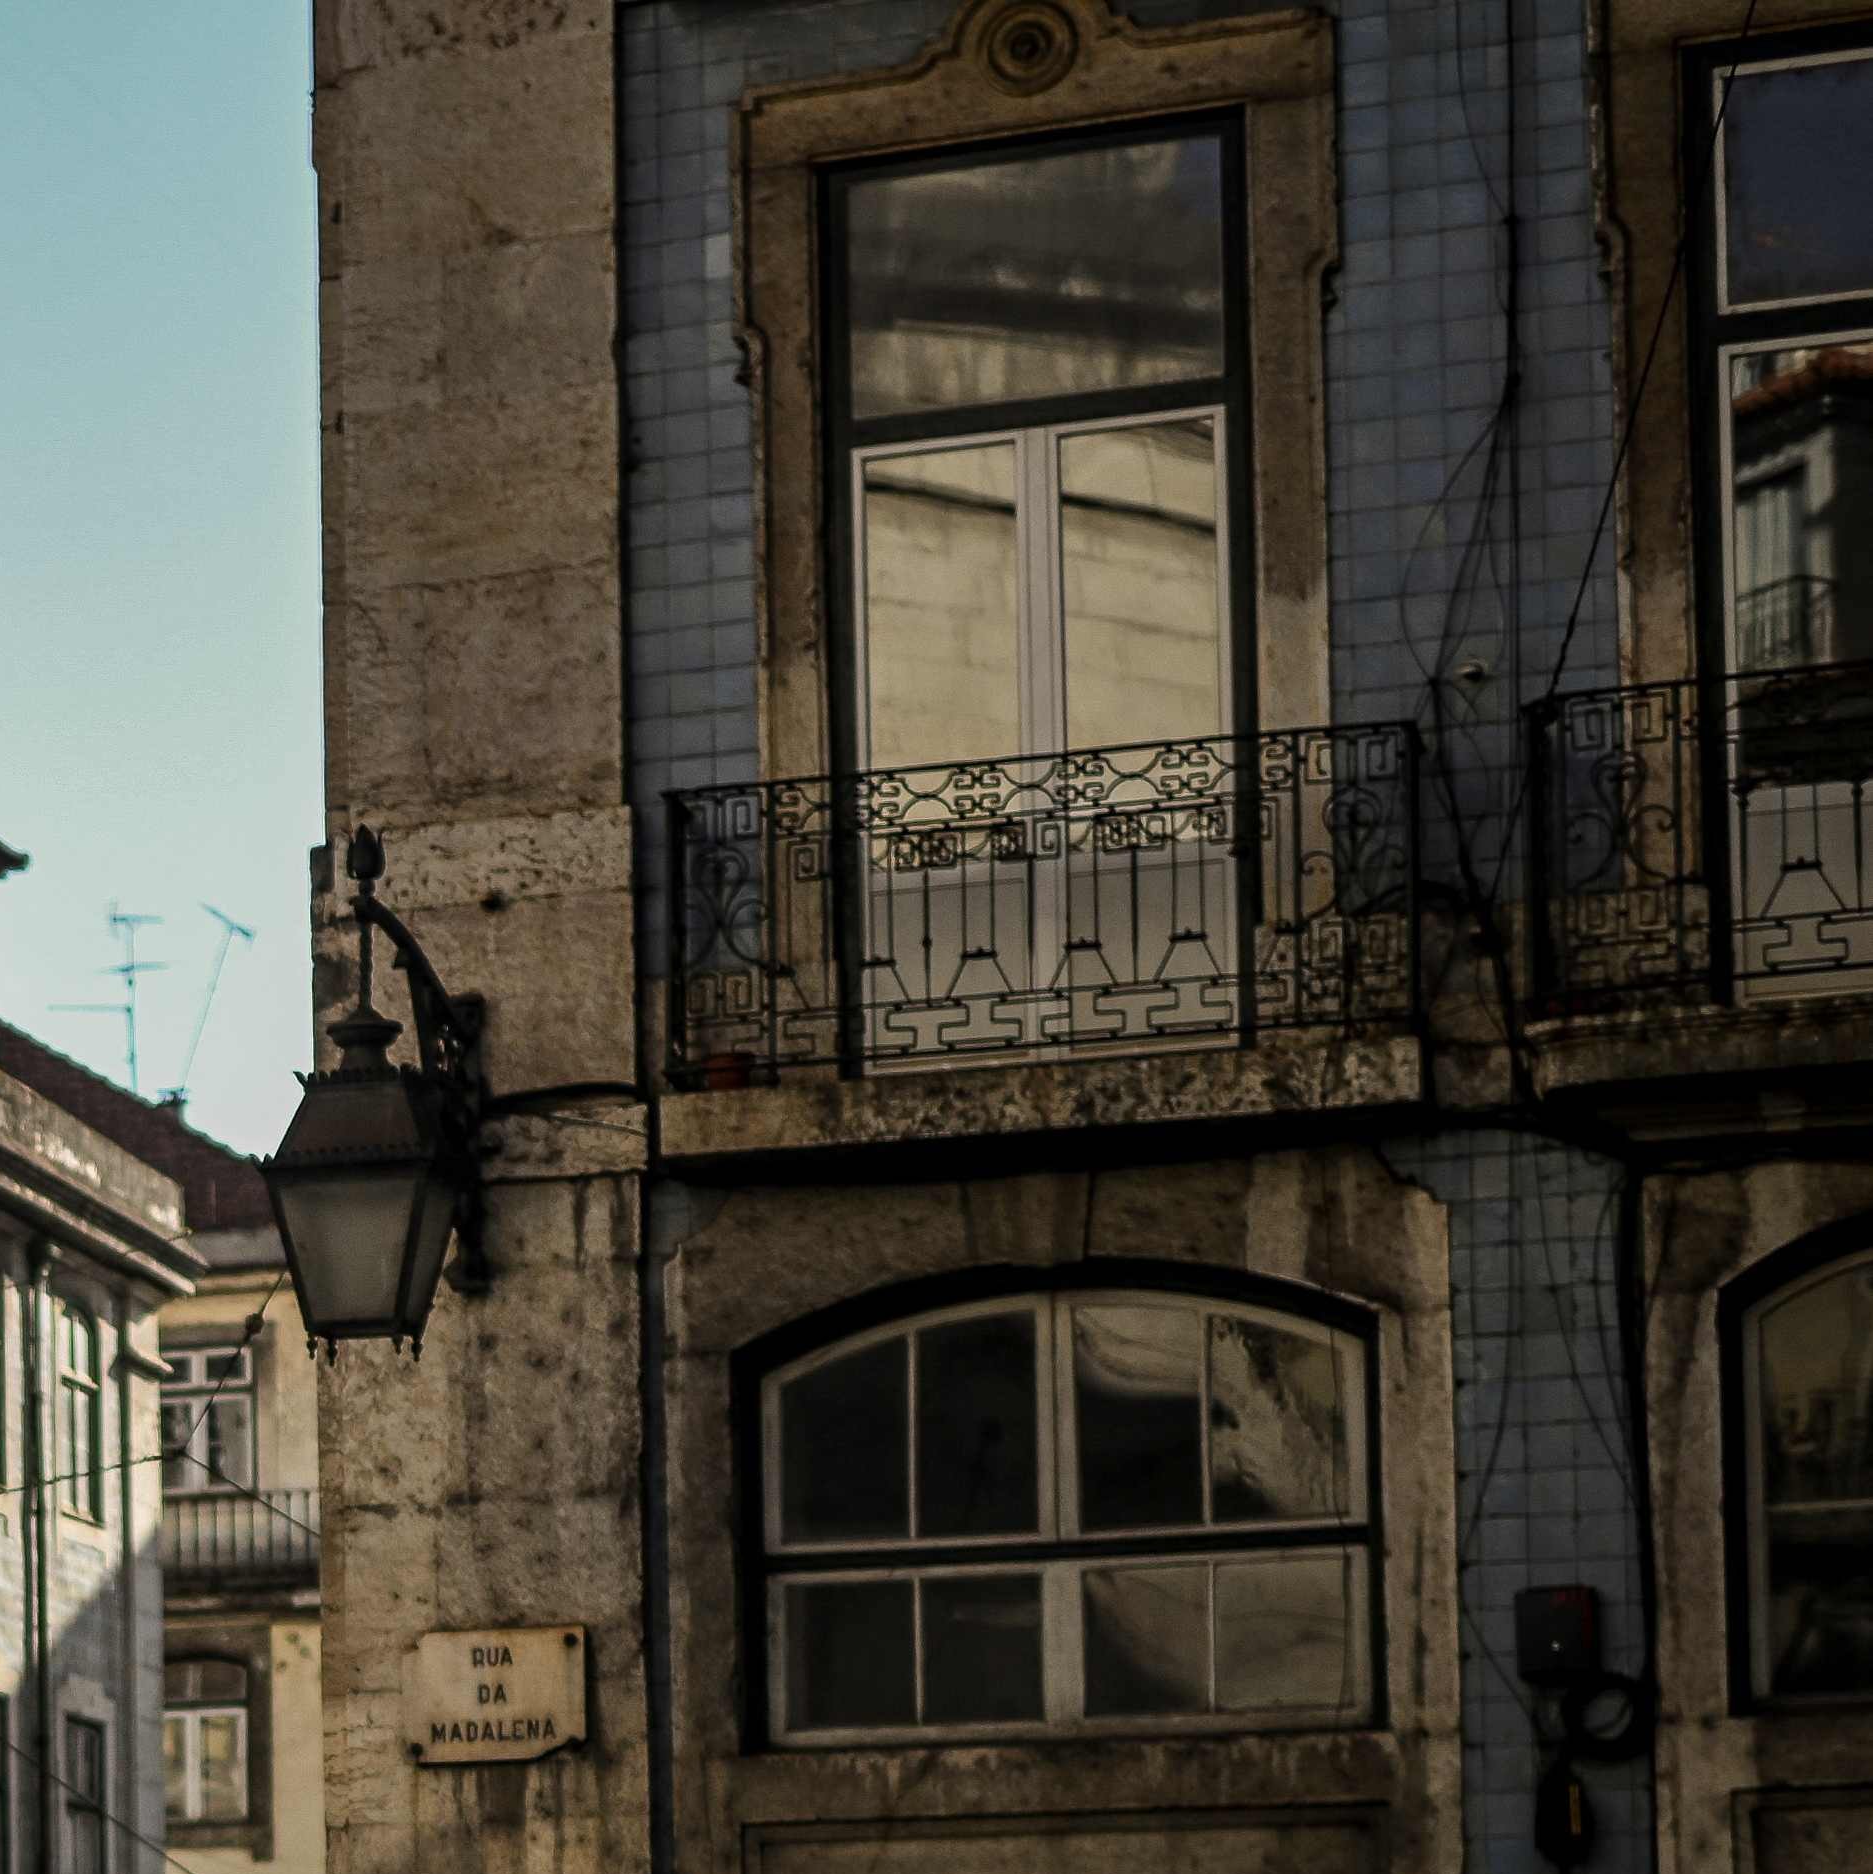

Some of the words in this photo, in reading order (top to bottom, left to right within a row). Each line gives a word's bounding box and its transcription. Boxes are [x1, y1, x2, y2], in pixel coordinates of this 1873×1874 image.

[472, 1646, 513, 1668] RUA
[478, 1683, 507, 1705] DA
[431, 1718, 556, 1744] MADALENA
